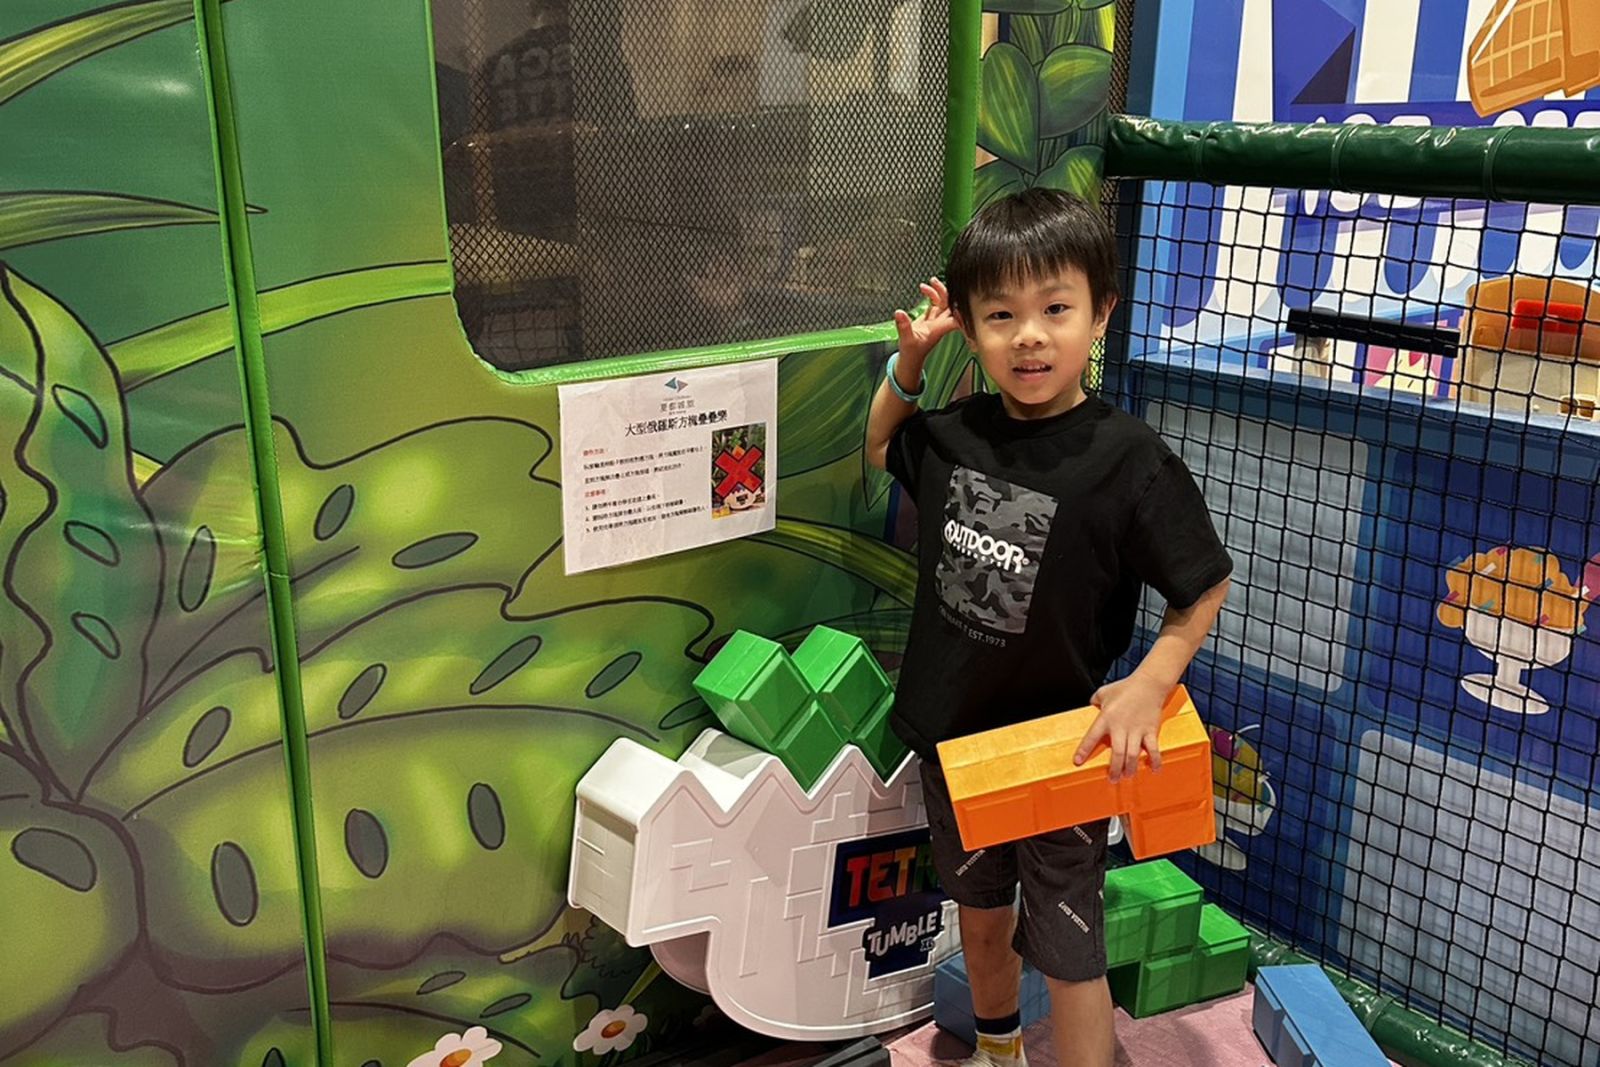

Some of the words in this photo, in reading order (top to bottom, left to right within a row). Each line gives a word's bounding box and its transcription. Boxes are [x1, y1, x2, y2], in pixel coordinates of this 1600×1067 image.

[944, 519, 1025, 574] OUTDOOR
[847, 843, 940, 908] TETR
[867, 910, 938, 957] TUMBLE
